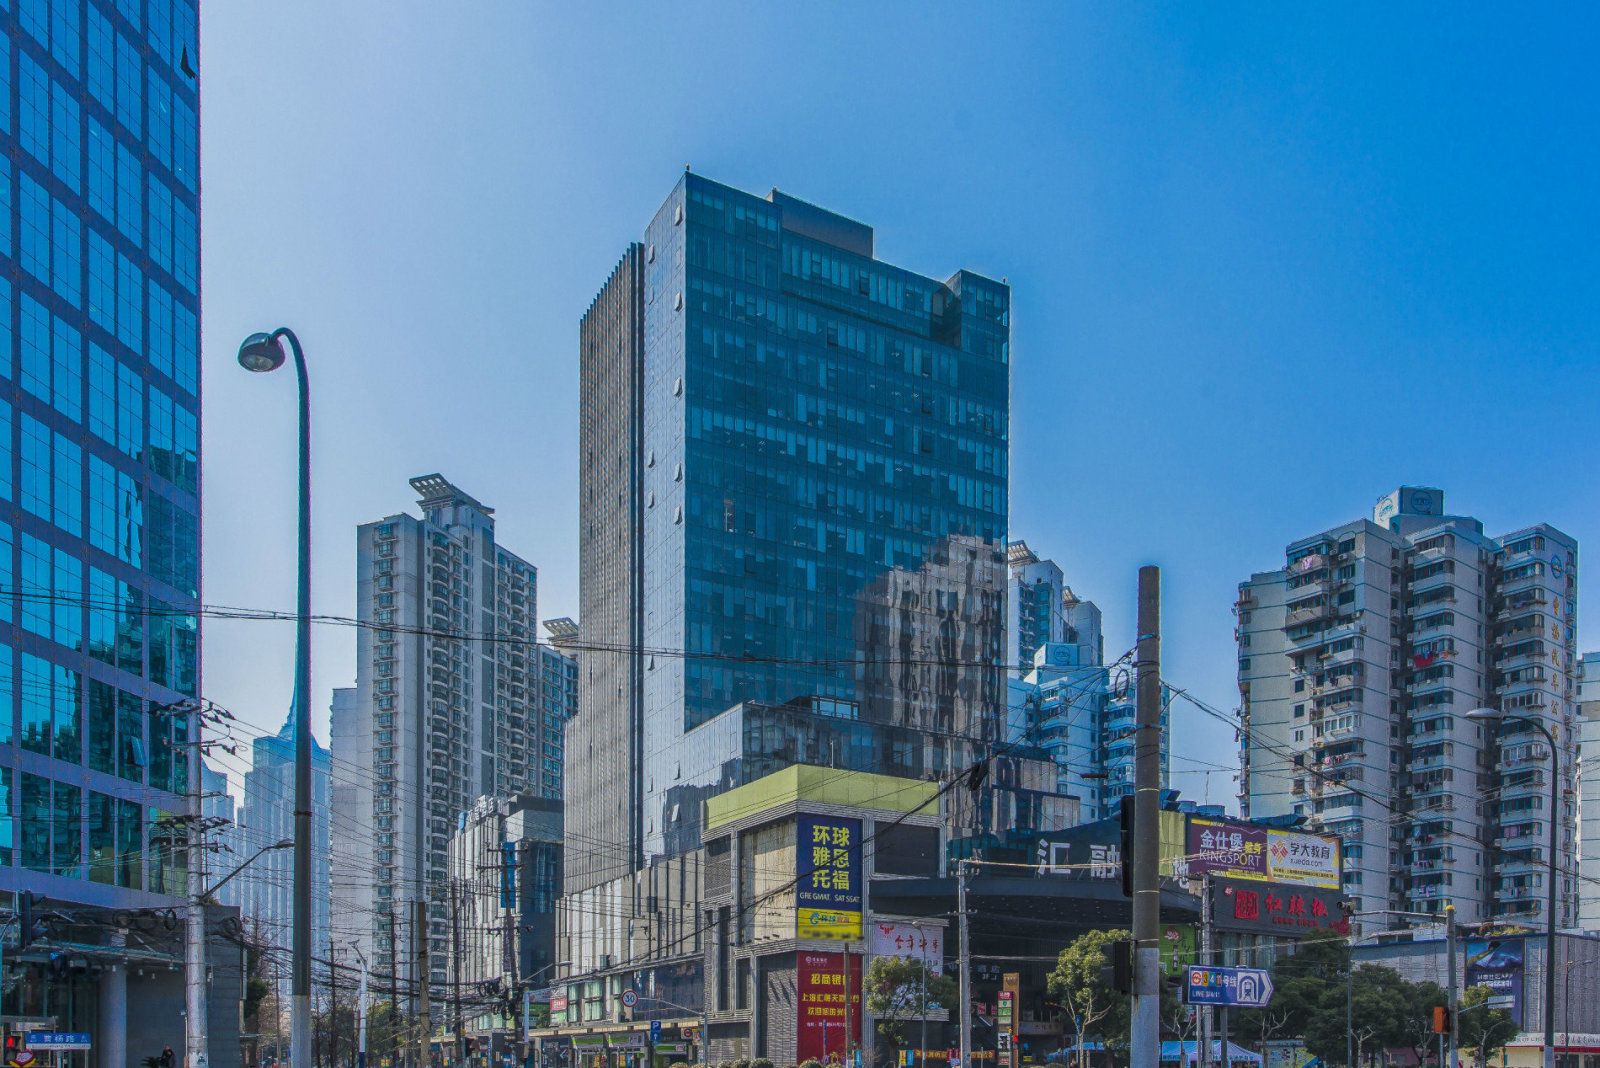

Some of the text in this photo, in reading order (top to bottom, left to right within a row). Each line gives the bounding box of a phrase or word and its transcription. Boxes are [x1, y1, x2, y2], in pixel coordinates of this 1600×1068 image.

[813, 825, 850, 846] 环球
[1200, 829, 1243, 852] 金仕堡
[813, 846, 850, 868] 雅思
[1200, 849, 1260, 867] KINGSPORT
[1290, 842, 1331, 860] 学大教育
[813, 869, 850, 890] 托福
[1265, 893, 1328, 918] 红辣椒
[1223, 975, 1237, 988] 号线
[625, 993, 635, 1003] 30
[652, 1021, 660, 1029] P
